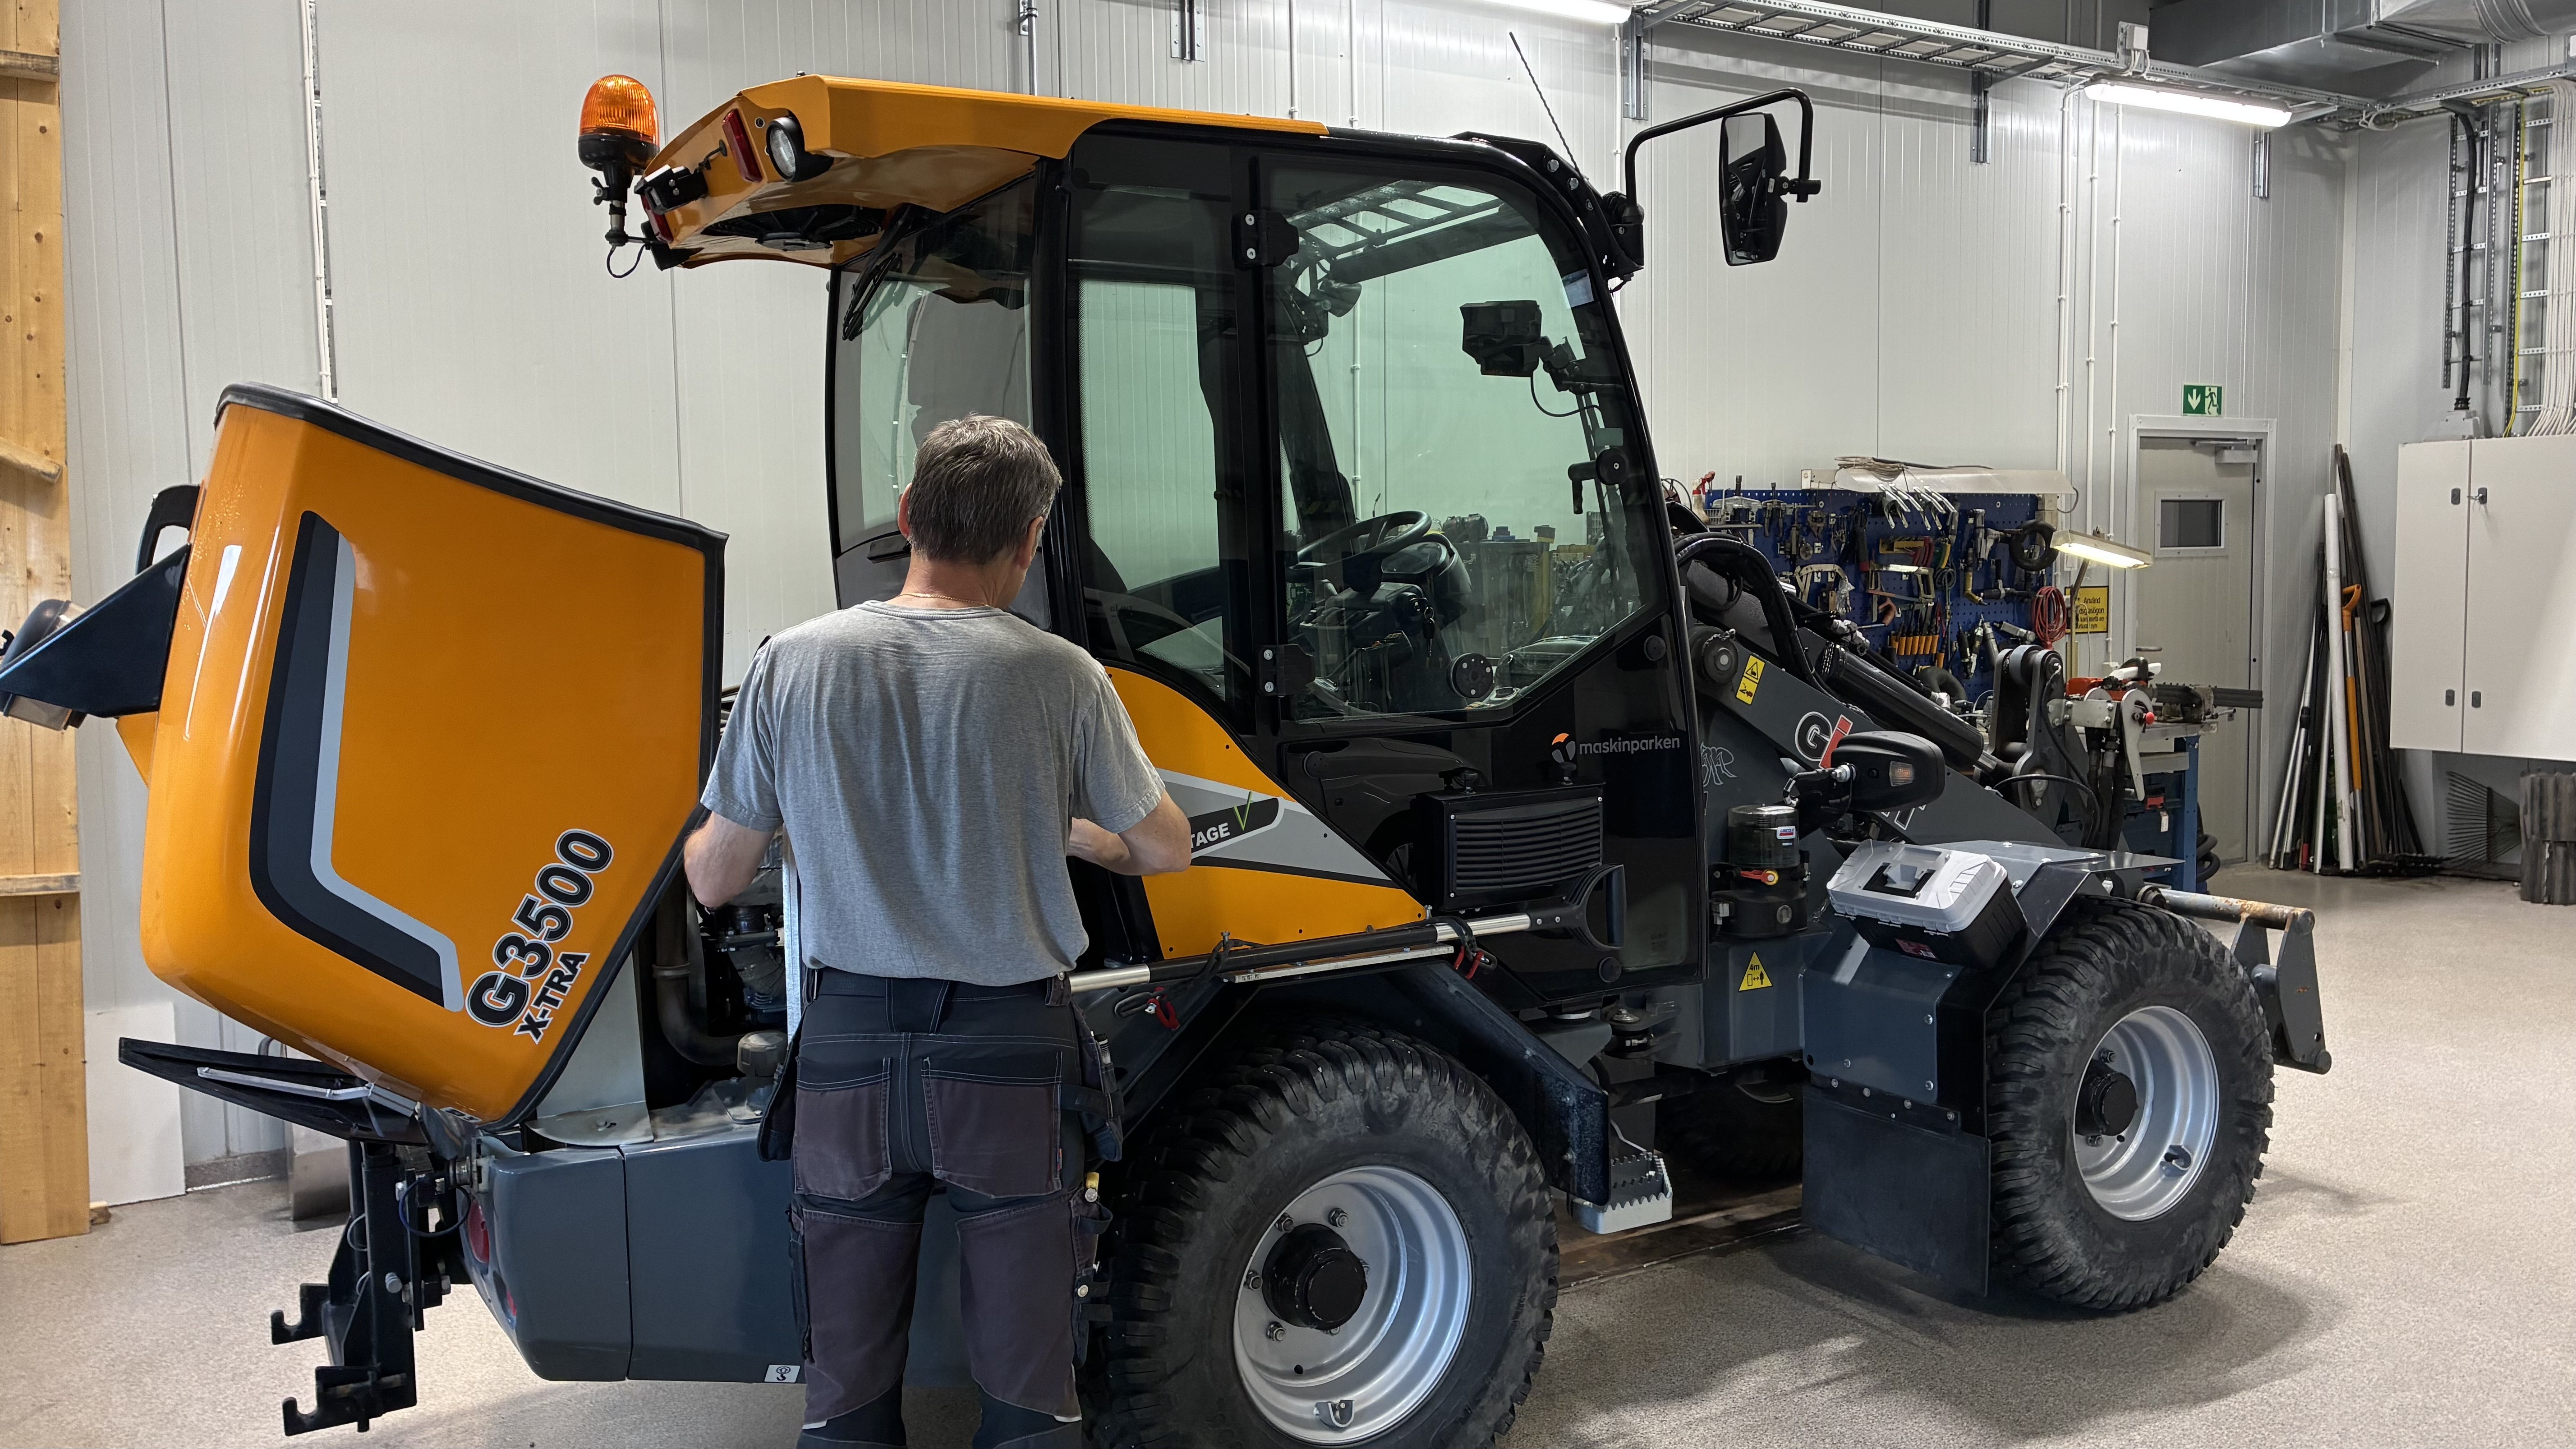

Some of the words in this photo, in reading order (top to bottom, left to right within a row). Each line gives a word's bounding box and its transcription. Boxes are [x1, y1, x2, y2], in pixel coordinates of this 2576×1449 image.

[1579, 736, 1680, 754] maskinparken
[1191, 822, 1230, 849] TAGE
[465, 828, 614, 1028] G3500
[513, 952, 590, 1044] X-TRA
